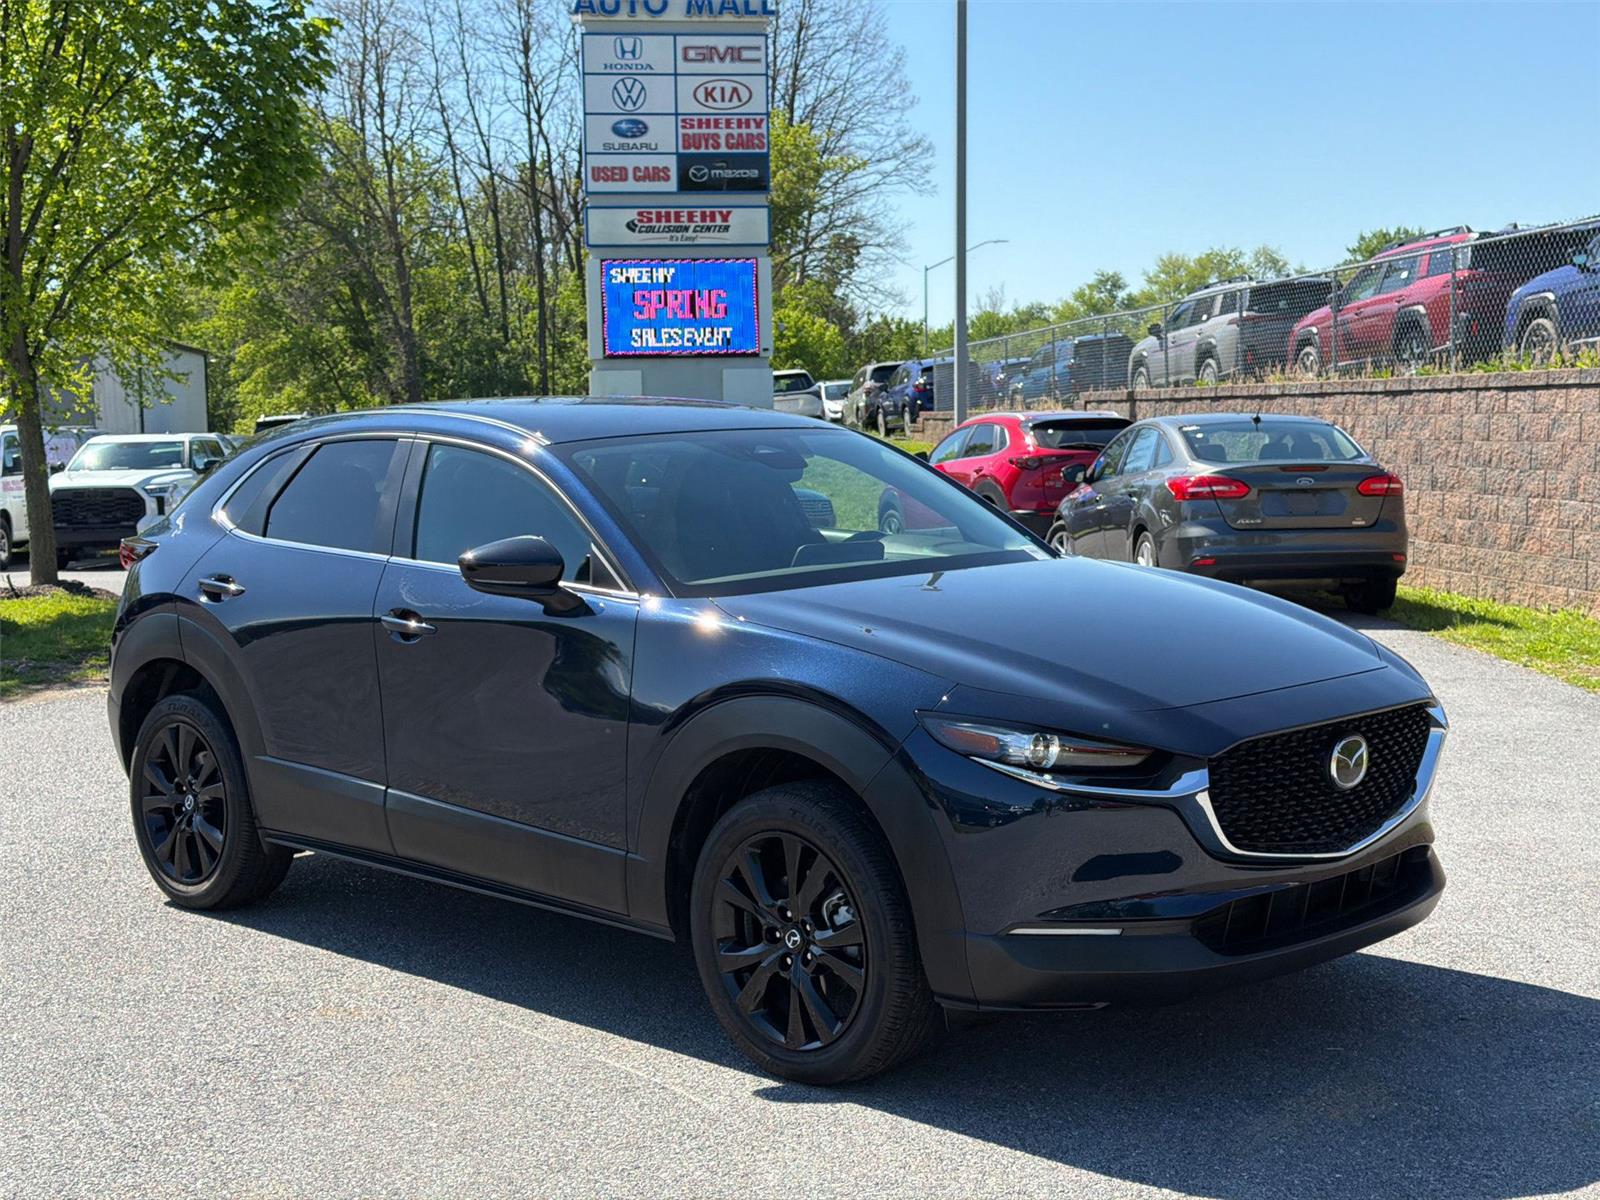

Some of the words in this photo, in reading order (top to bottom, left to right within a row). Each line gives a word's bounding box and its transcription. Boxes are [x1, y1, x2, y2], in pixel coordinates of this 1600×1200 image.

[682, 45, 762, 64] GMC
[603, 63, 654, 71] HONDA
[704, 86, 742, 103] KIA
[680, 118, 765, 130] SHEEHY
[602, 142, 658, 151] SUBARU
[681, 133, 721, 151] BUYS
[725, 133, 766, 151] CARS
[591, 166, 629, 182] USED
[633, 166, 671, 182] CARS
[710, 169, 759, 179] mazda
[636, 210, 733, 224] SHEEHY
[637, 225, 689, 234] COLLISION
[692, 224, 731, 233] CENTER
[609, 267, 675, 284] SHEEHY
[633, 289, 727, 320] SPRING
[631, 327, 682, 348] SALES
[683, 327, 733, 347] EVENT
